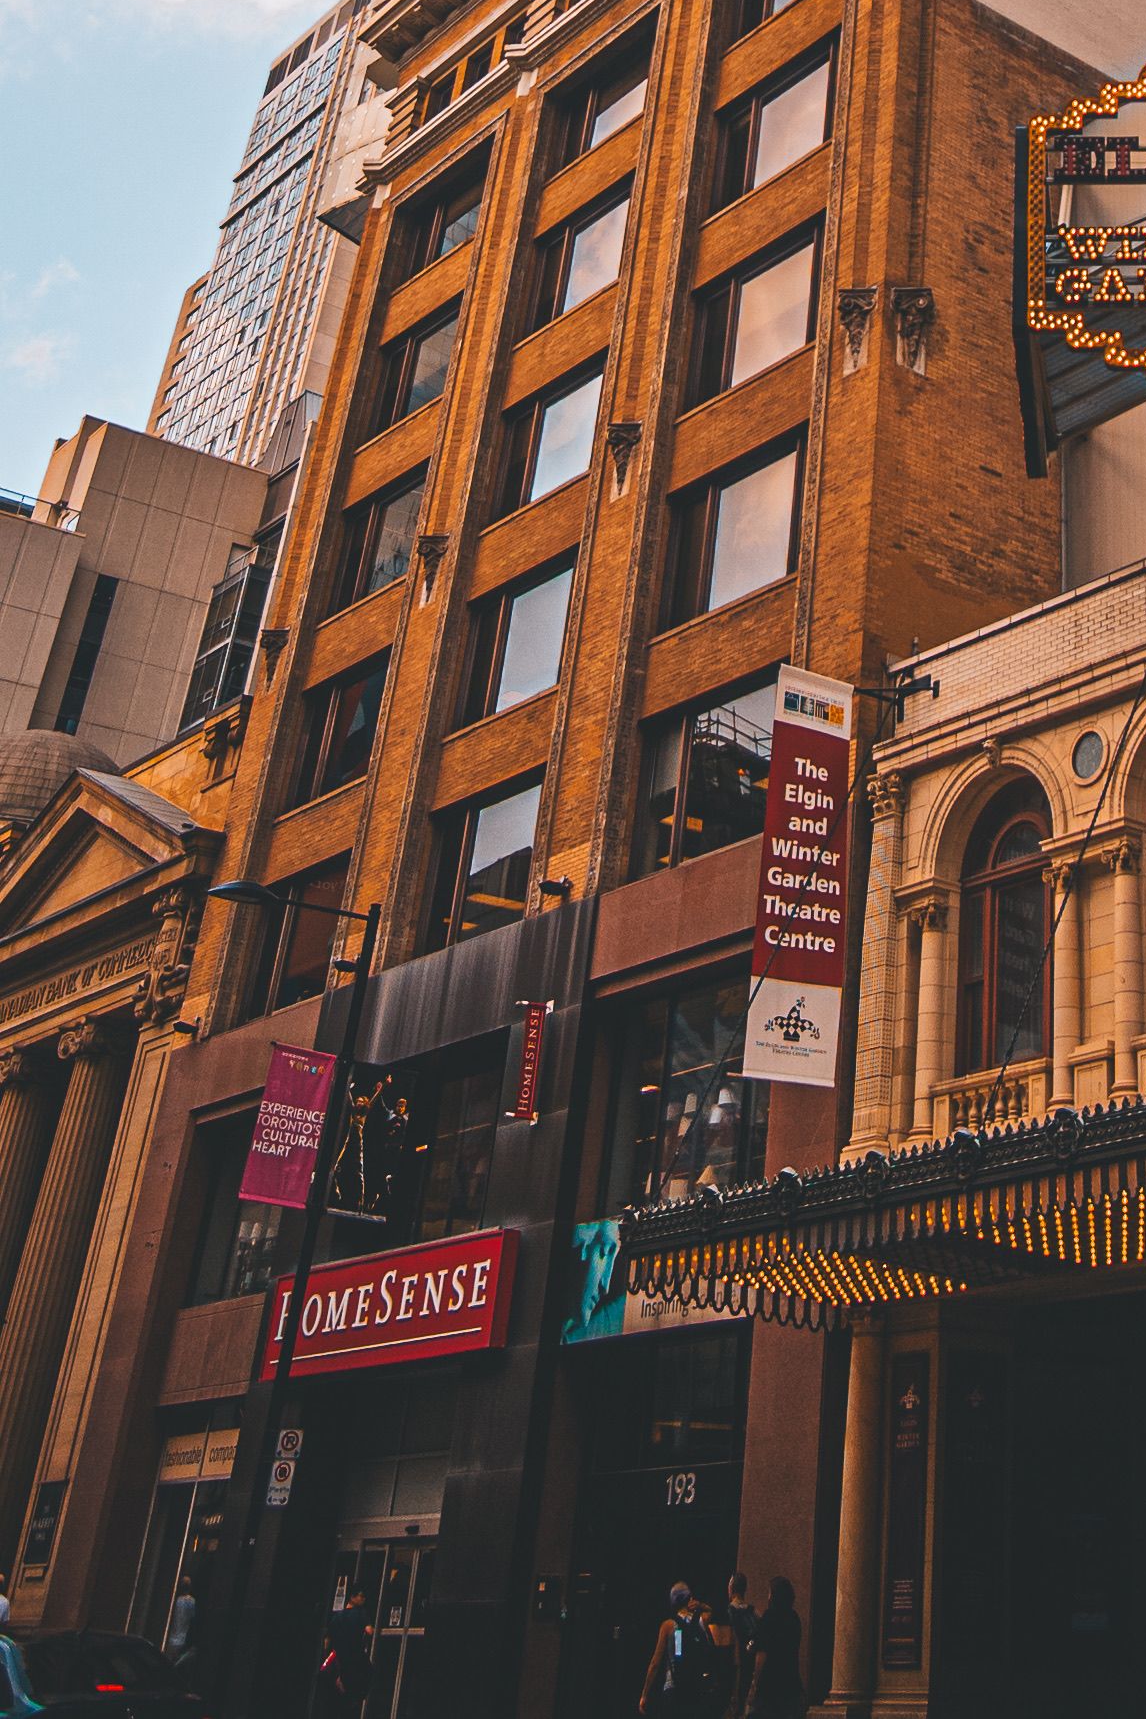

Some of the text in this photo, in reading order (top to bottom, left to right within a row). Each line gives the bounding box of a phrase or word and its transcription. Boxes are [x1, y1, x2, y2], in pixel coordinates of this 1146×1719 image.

[794, 757, 829, 782] The
[784, 783, 834, 810] Elgin
[788, 815, 828, 836] and
[771, 837, 841, 867] Winter
[767, 866, 841, 896] Garden
[763, 894, 841, 924] Theatre
[764, 924, 836, 953] Centre
[257, 1113, 322, 1136] TORONTO'S
[259, 1100, 326, 1124] EXPERIENCE
[252, 1139, 292, 1158] HEART
[261, 1128, 320, 1149] CULTURAL
[666, 1472, 697, 1506] 193
